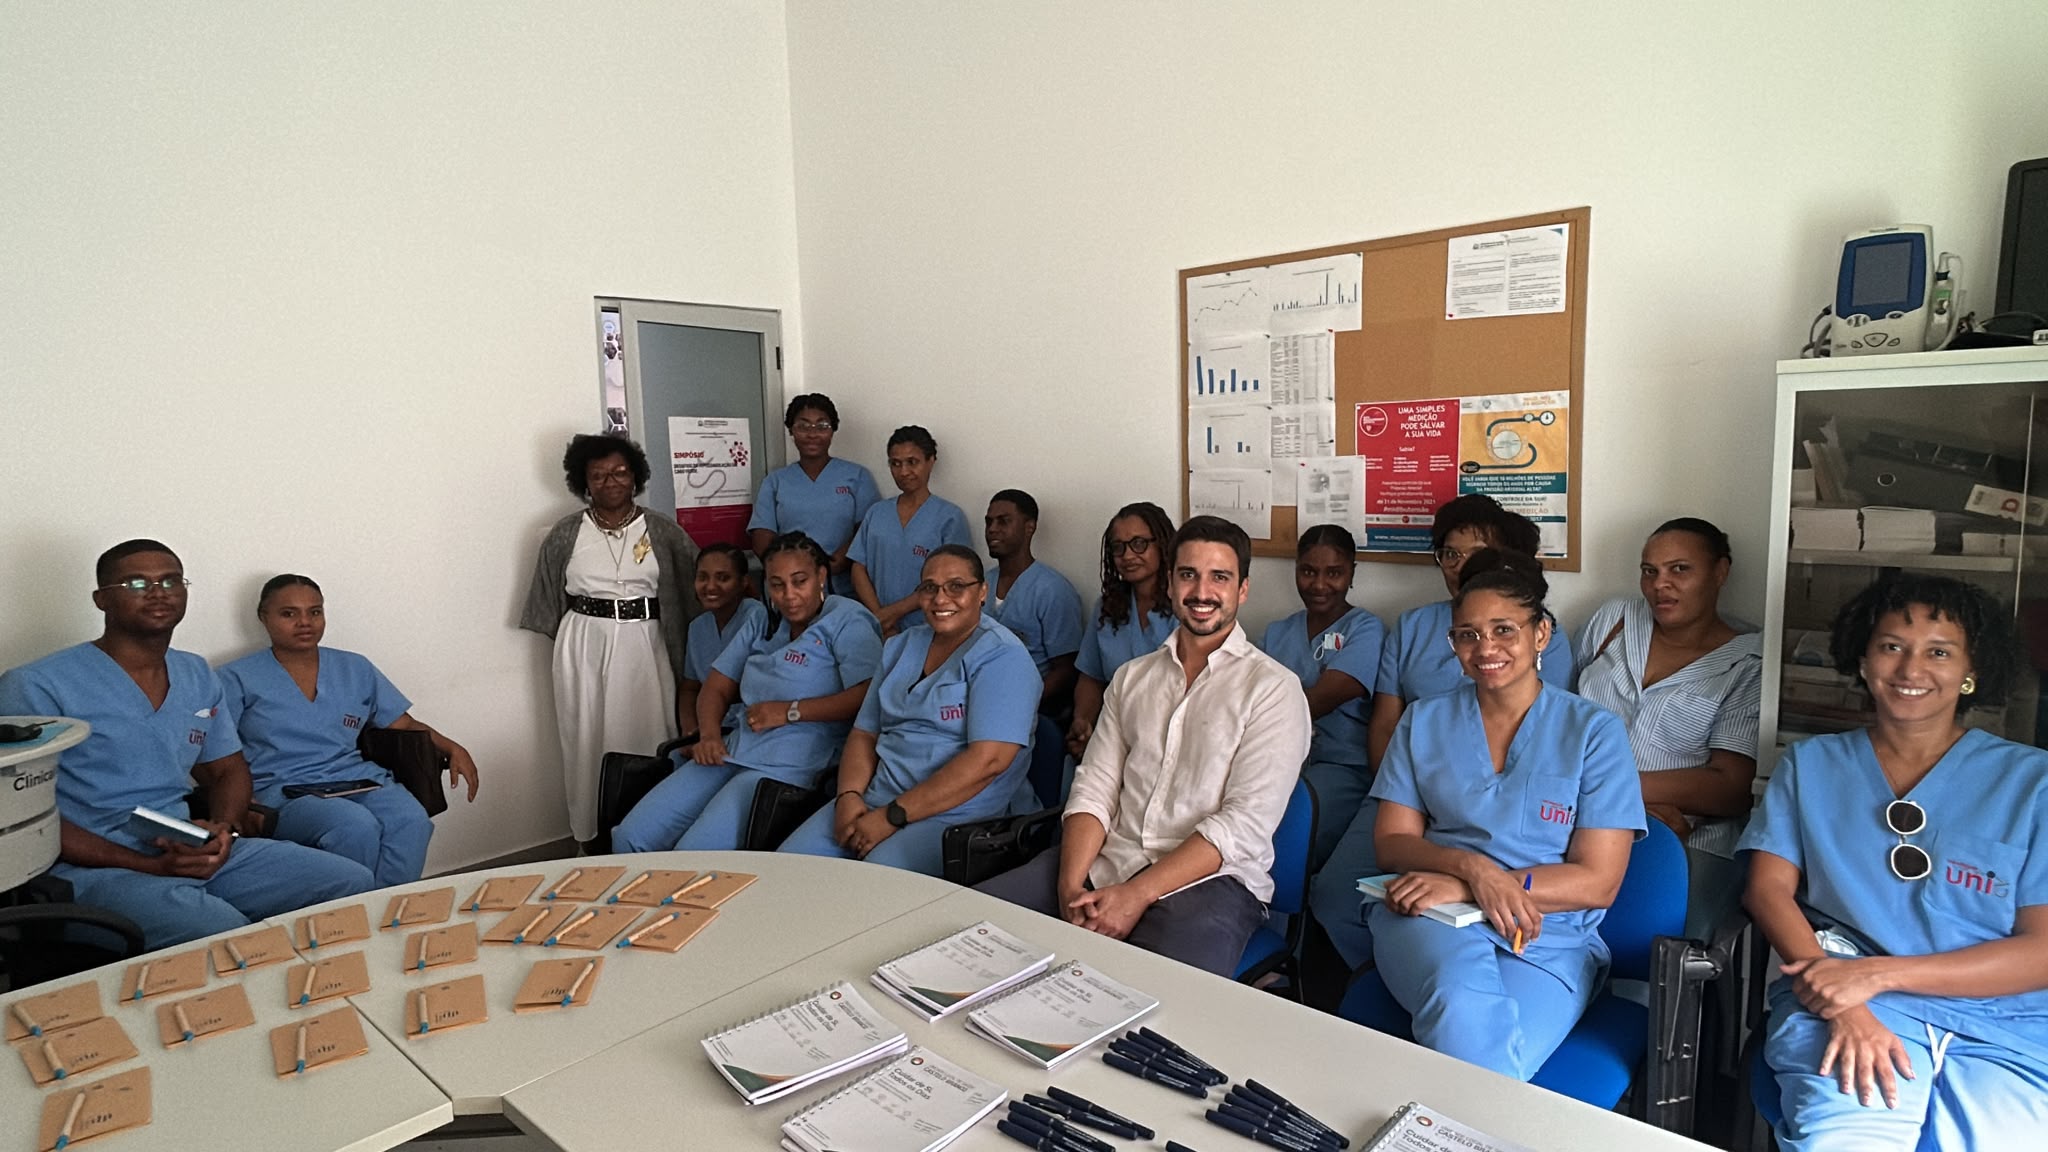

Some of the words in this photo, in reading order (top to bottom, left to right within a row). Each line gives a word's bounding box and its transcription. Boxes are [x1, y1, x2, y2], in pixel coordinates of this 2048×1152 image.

[1416, 405, 1445, 413] SIMPLES
[1408, 413, 1438, 422] MEDIÇÃO
[1420, 421, 1446, 429] SALVAR
[894, 1067, 917, 1083] Cuidar
[915, 1088, 931, 1100] Dias
[1405, 1128, 1440, 1148] Cuidar
[1437, 1128, 1473, 1148] CASTELO
